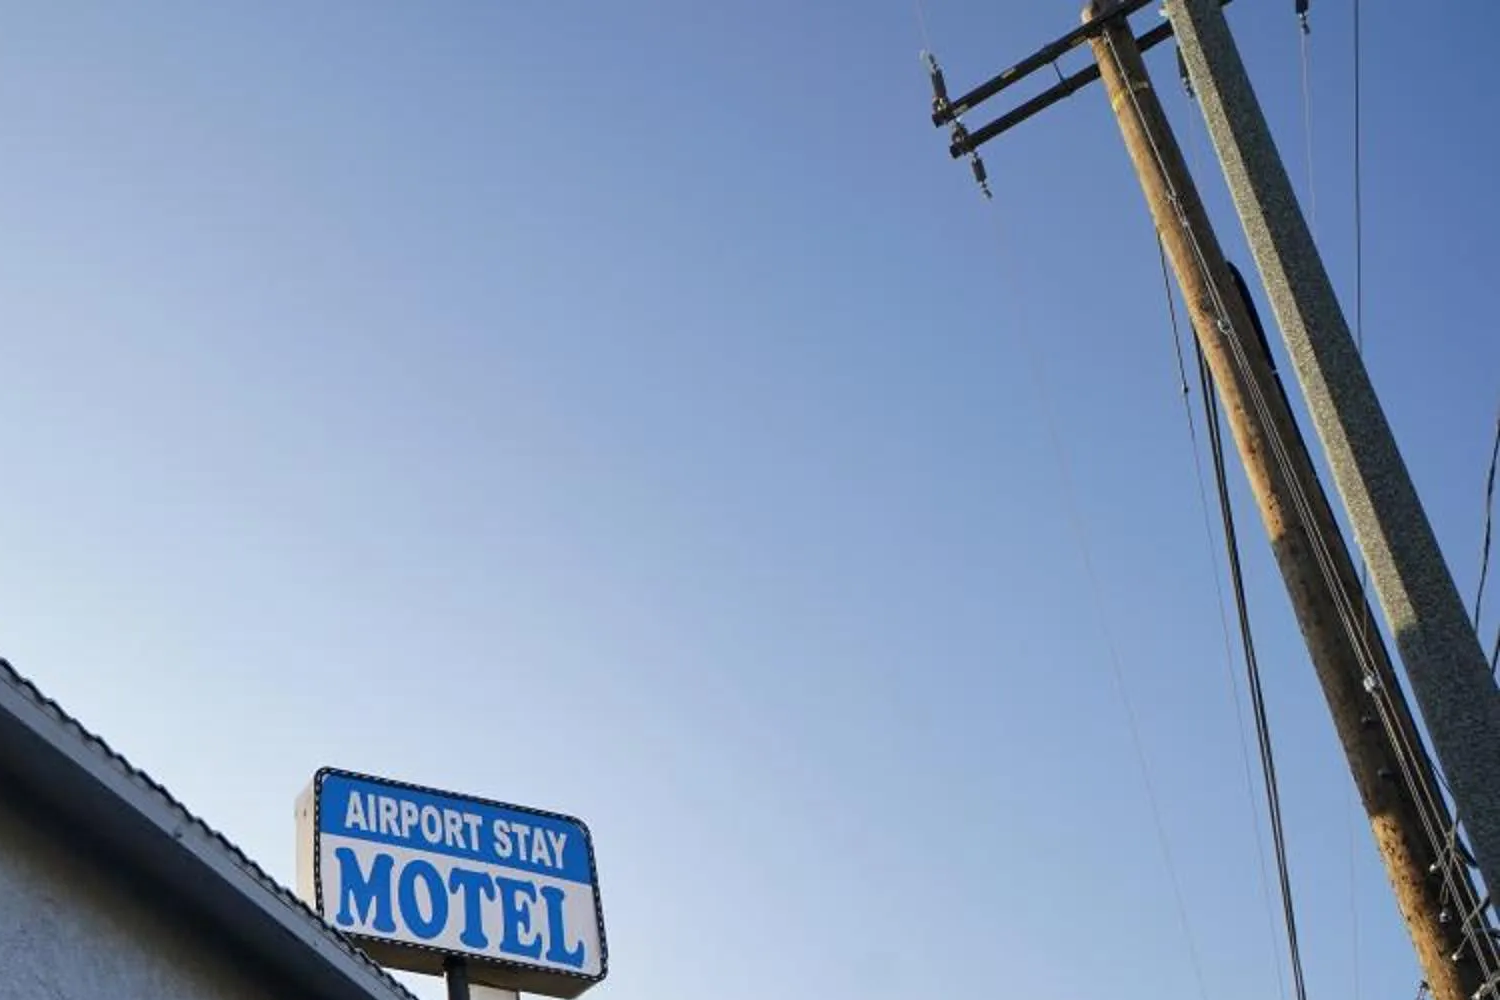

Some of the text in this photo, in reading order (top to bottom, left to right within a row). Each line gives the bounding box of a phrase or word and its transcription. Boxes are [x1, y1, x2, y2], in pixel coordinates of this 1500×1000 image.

[345, 791, 568, 870] AIRPORT STAY
[335, 847, 585, 969] MOTEL
